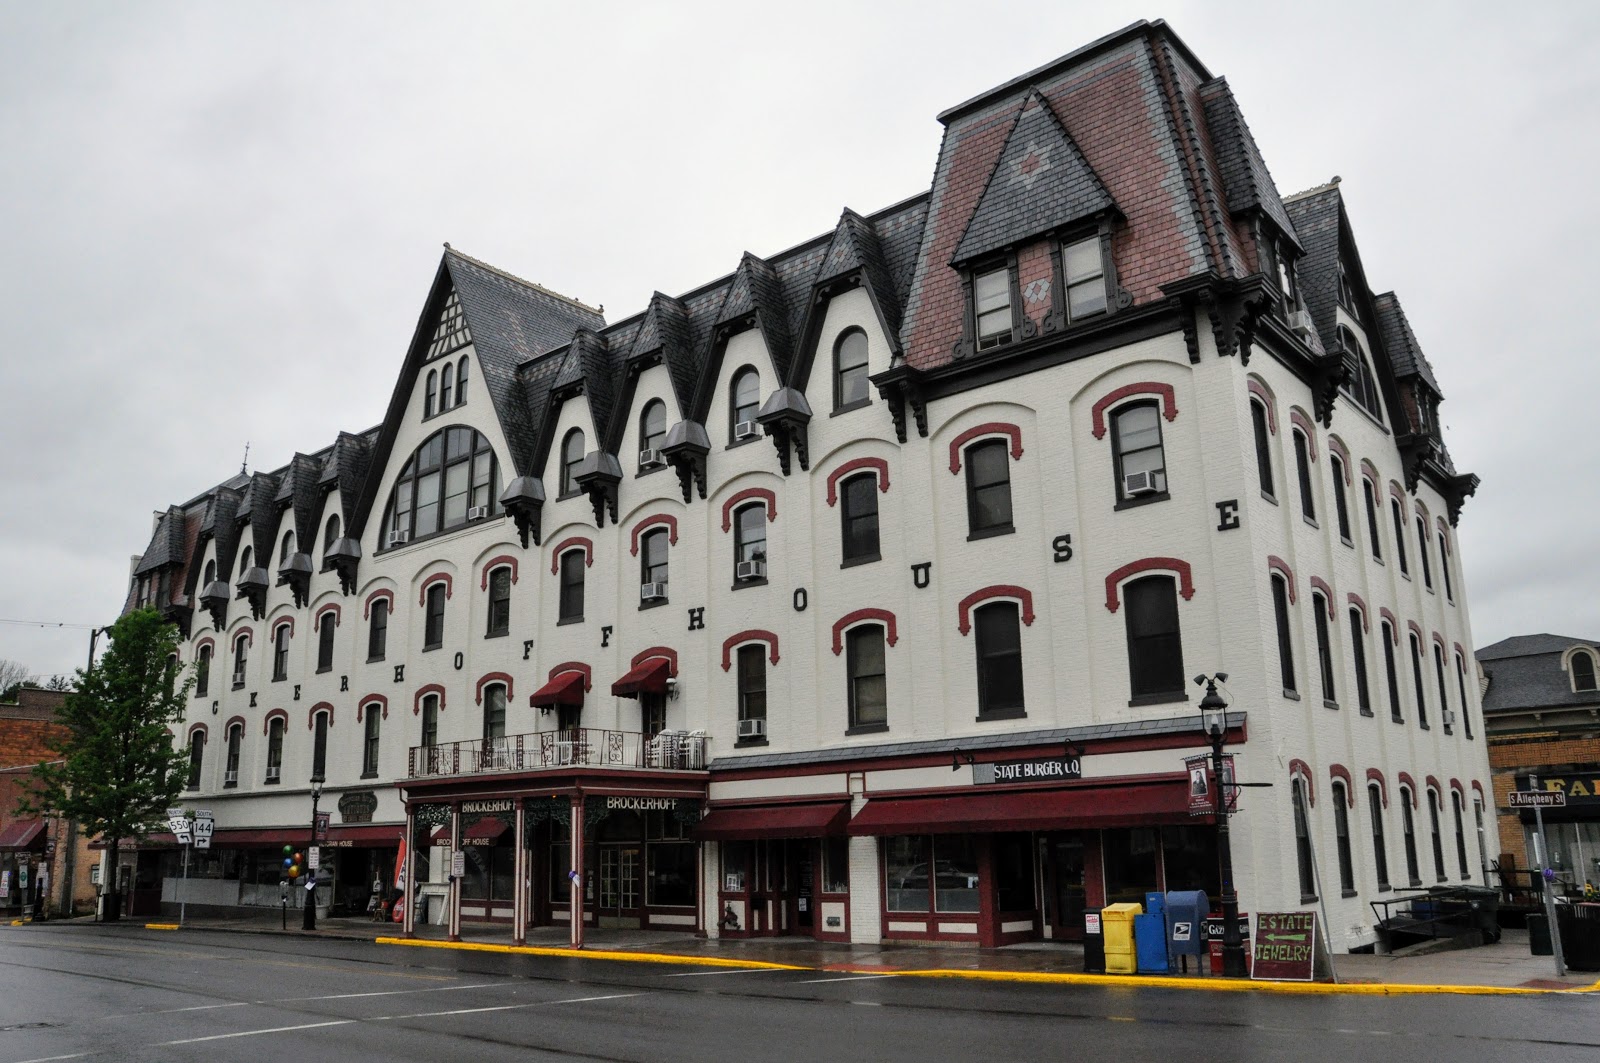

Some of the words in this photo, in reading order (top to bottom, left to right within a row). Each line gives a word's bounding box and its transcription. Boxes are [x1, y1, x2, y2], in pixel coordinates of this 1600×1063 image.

[994, 764, 1022, 779] STATE
[1024, 761, 1063, 776] BURGER
[462, 799, 516, 812] BROCKERHOFF
[607, 796, 678, 810] BROCKERHOFF
[1510, 795, 1515, 804] S
[1516, 792, 1554, 806] Allegheny
[1555, 794, 1564, 803] St
[170, 820, 189, 831] 550
[195, 823, 211, 833] 144
[472, 838, 490, 846] HOUSE
[1259, 914, 1313, 930] ESTATE
[1255, 944, 1311, 961] JEWELRY
